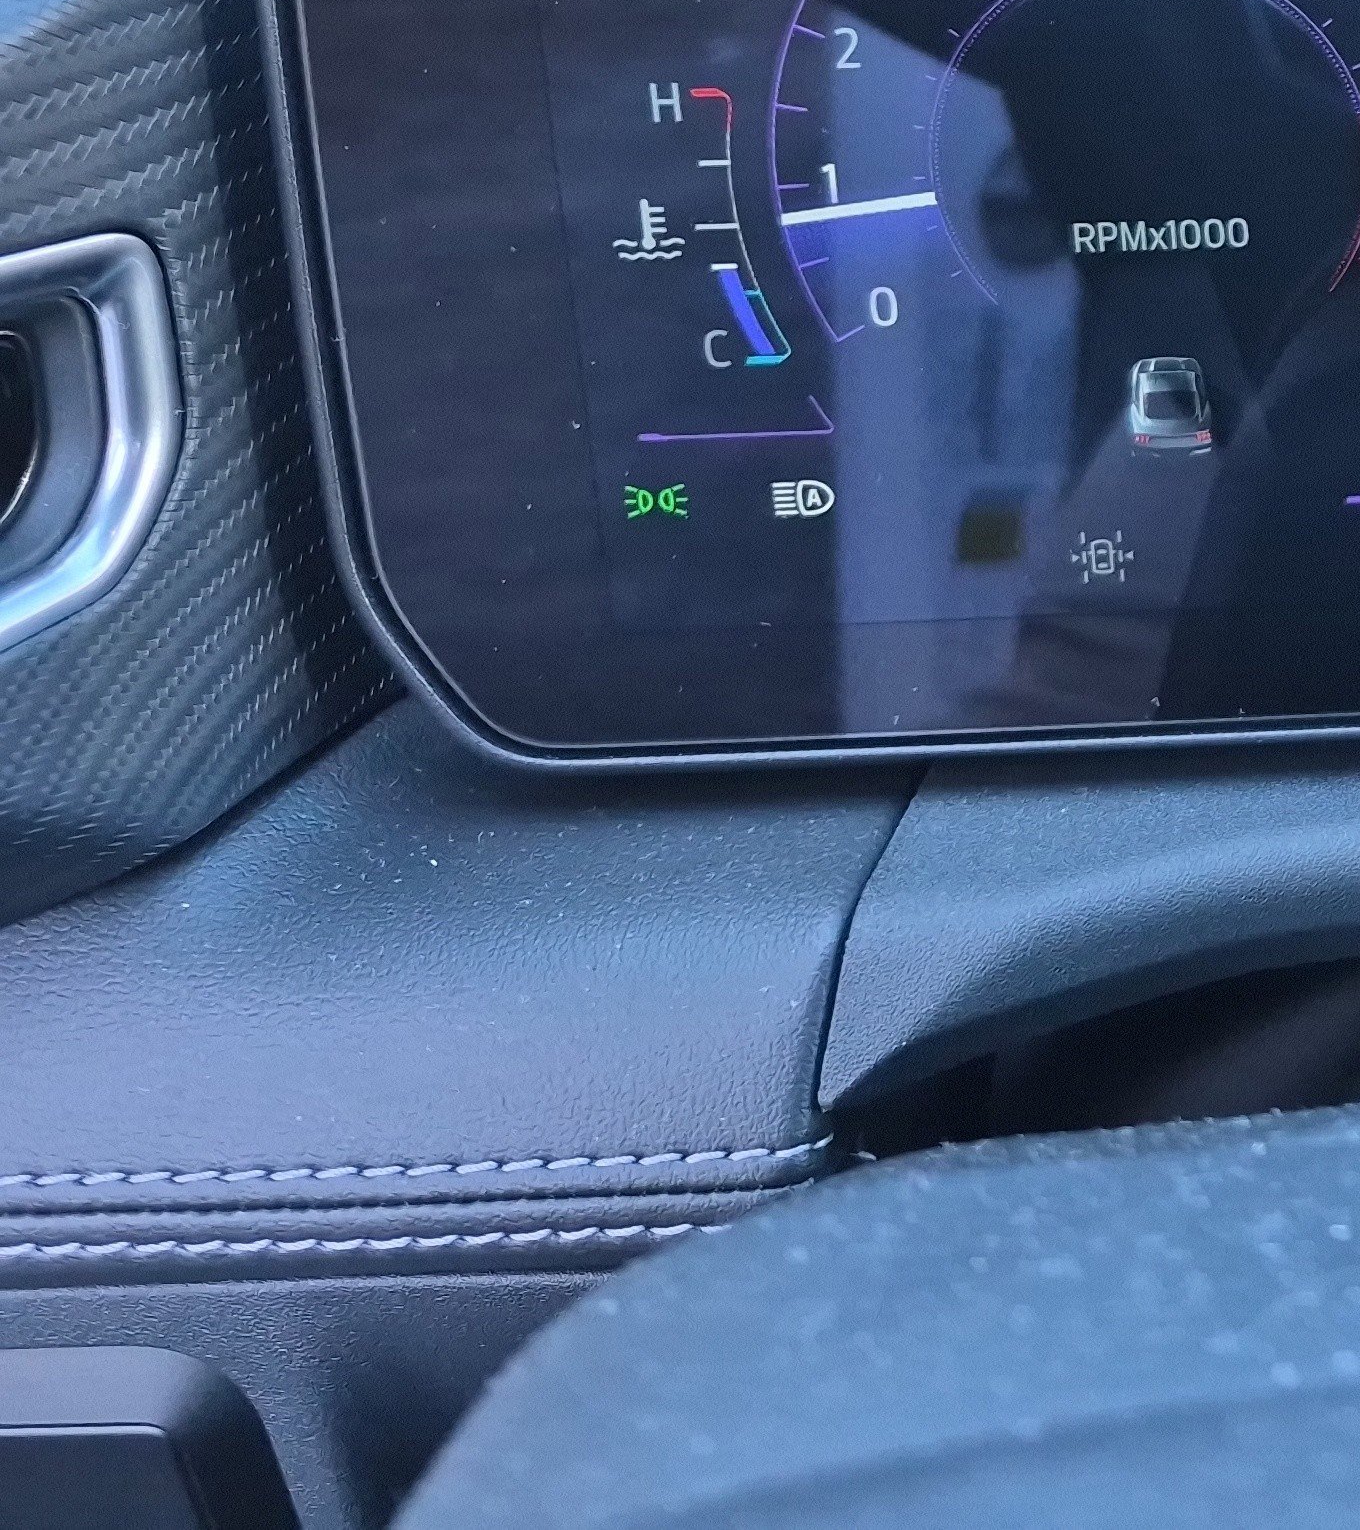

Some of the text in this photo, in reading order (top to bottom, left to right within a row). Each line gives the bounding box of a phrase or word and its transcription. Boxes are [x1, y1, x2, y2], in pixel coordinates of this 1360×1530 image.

[834, 27, 862, 70] 2
[649, 82, 683, 123] H
[821, 163, 840, 204] 1
[1072, 217, 1250, 253] RPMx1000
[868, 286, 898, 327] 0
[703, 329, 732, 368] C
